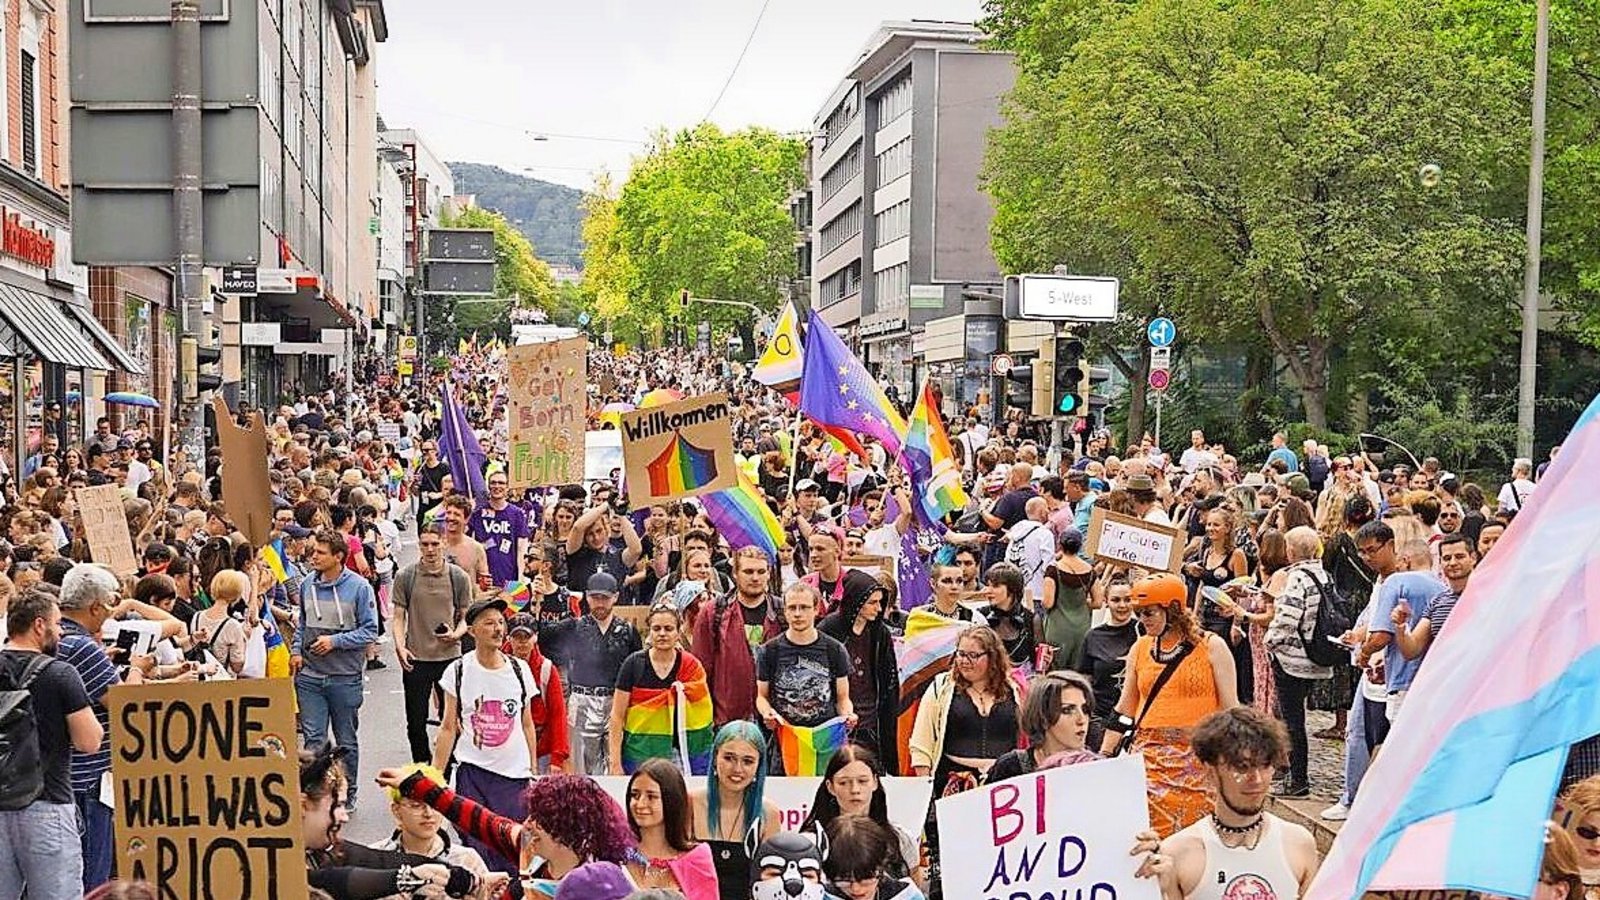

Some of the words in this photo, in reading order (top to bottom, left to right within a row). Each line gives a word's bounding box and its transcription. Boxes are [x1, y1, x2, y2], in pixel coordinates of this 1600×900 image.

[482, 519, 511, 534] Volt
[120, 696, 271, 764] STONE
[122, 773, 201, 828] WALL
[205, 772, 291, 831] WAS
[989, 774, 1046, 847] BI
[156, 836, 294, 900] RIOT
[983, 835, 1087, 894] AND
